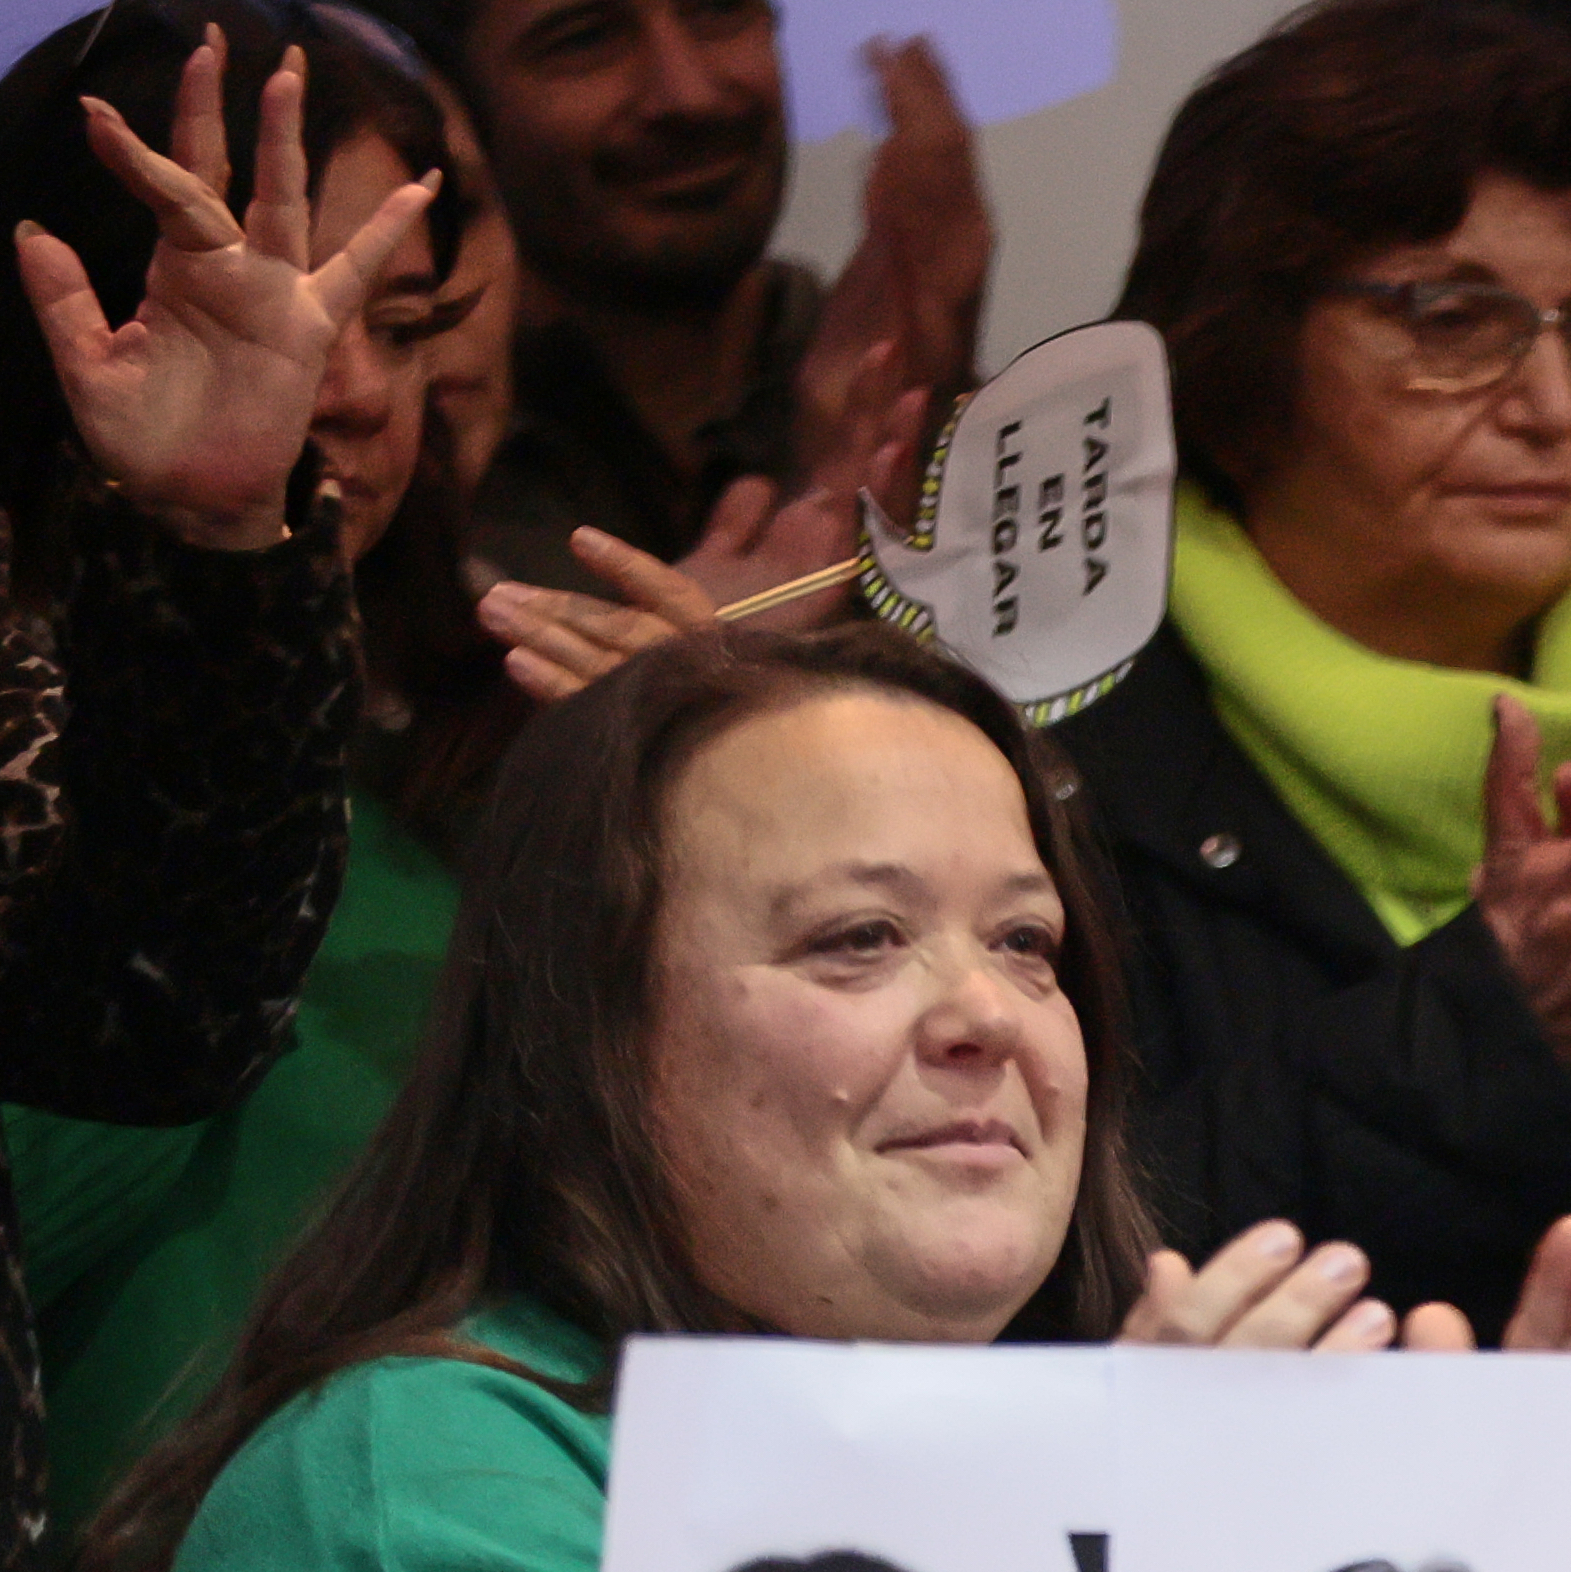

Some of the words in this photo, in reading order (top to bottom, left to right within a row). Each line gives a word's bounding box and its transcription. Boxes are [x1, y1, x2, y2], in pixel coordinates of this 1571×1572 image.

[993, 421, 1023, 638] LLEGAR
[1039, 472, 1065, 552] EN
[1083, 396, 1112, 597] TARDA
